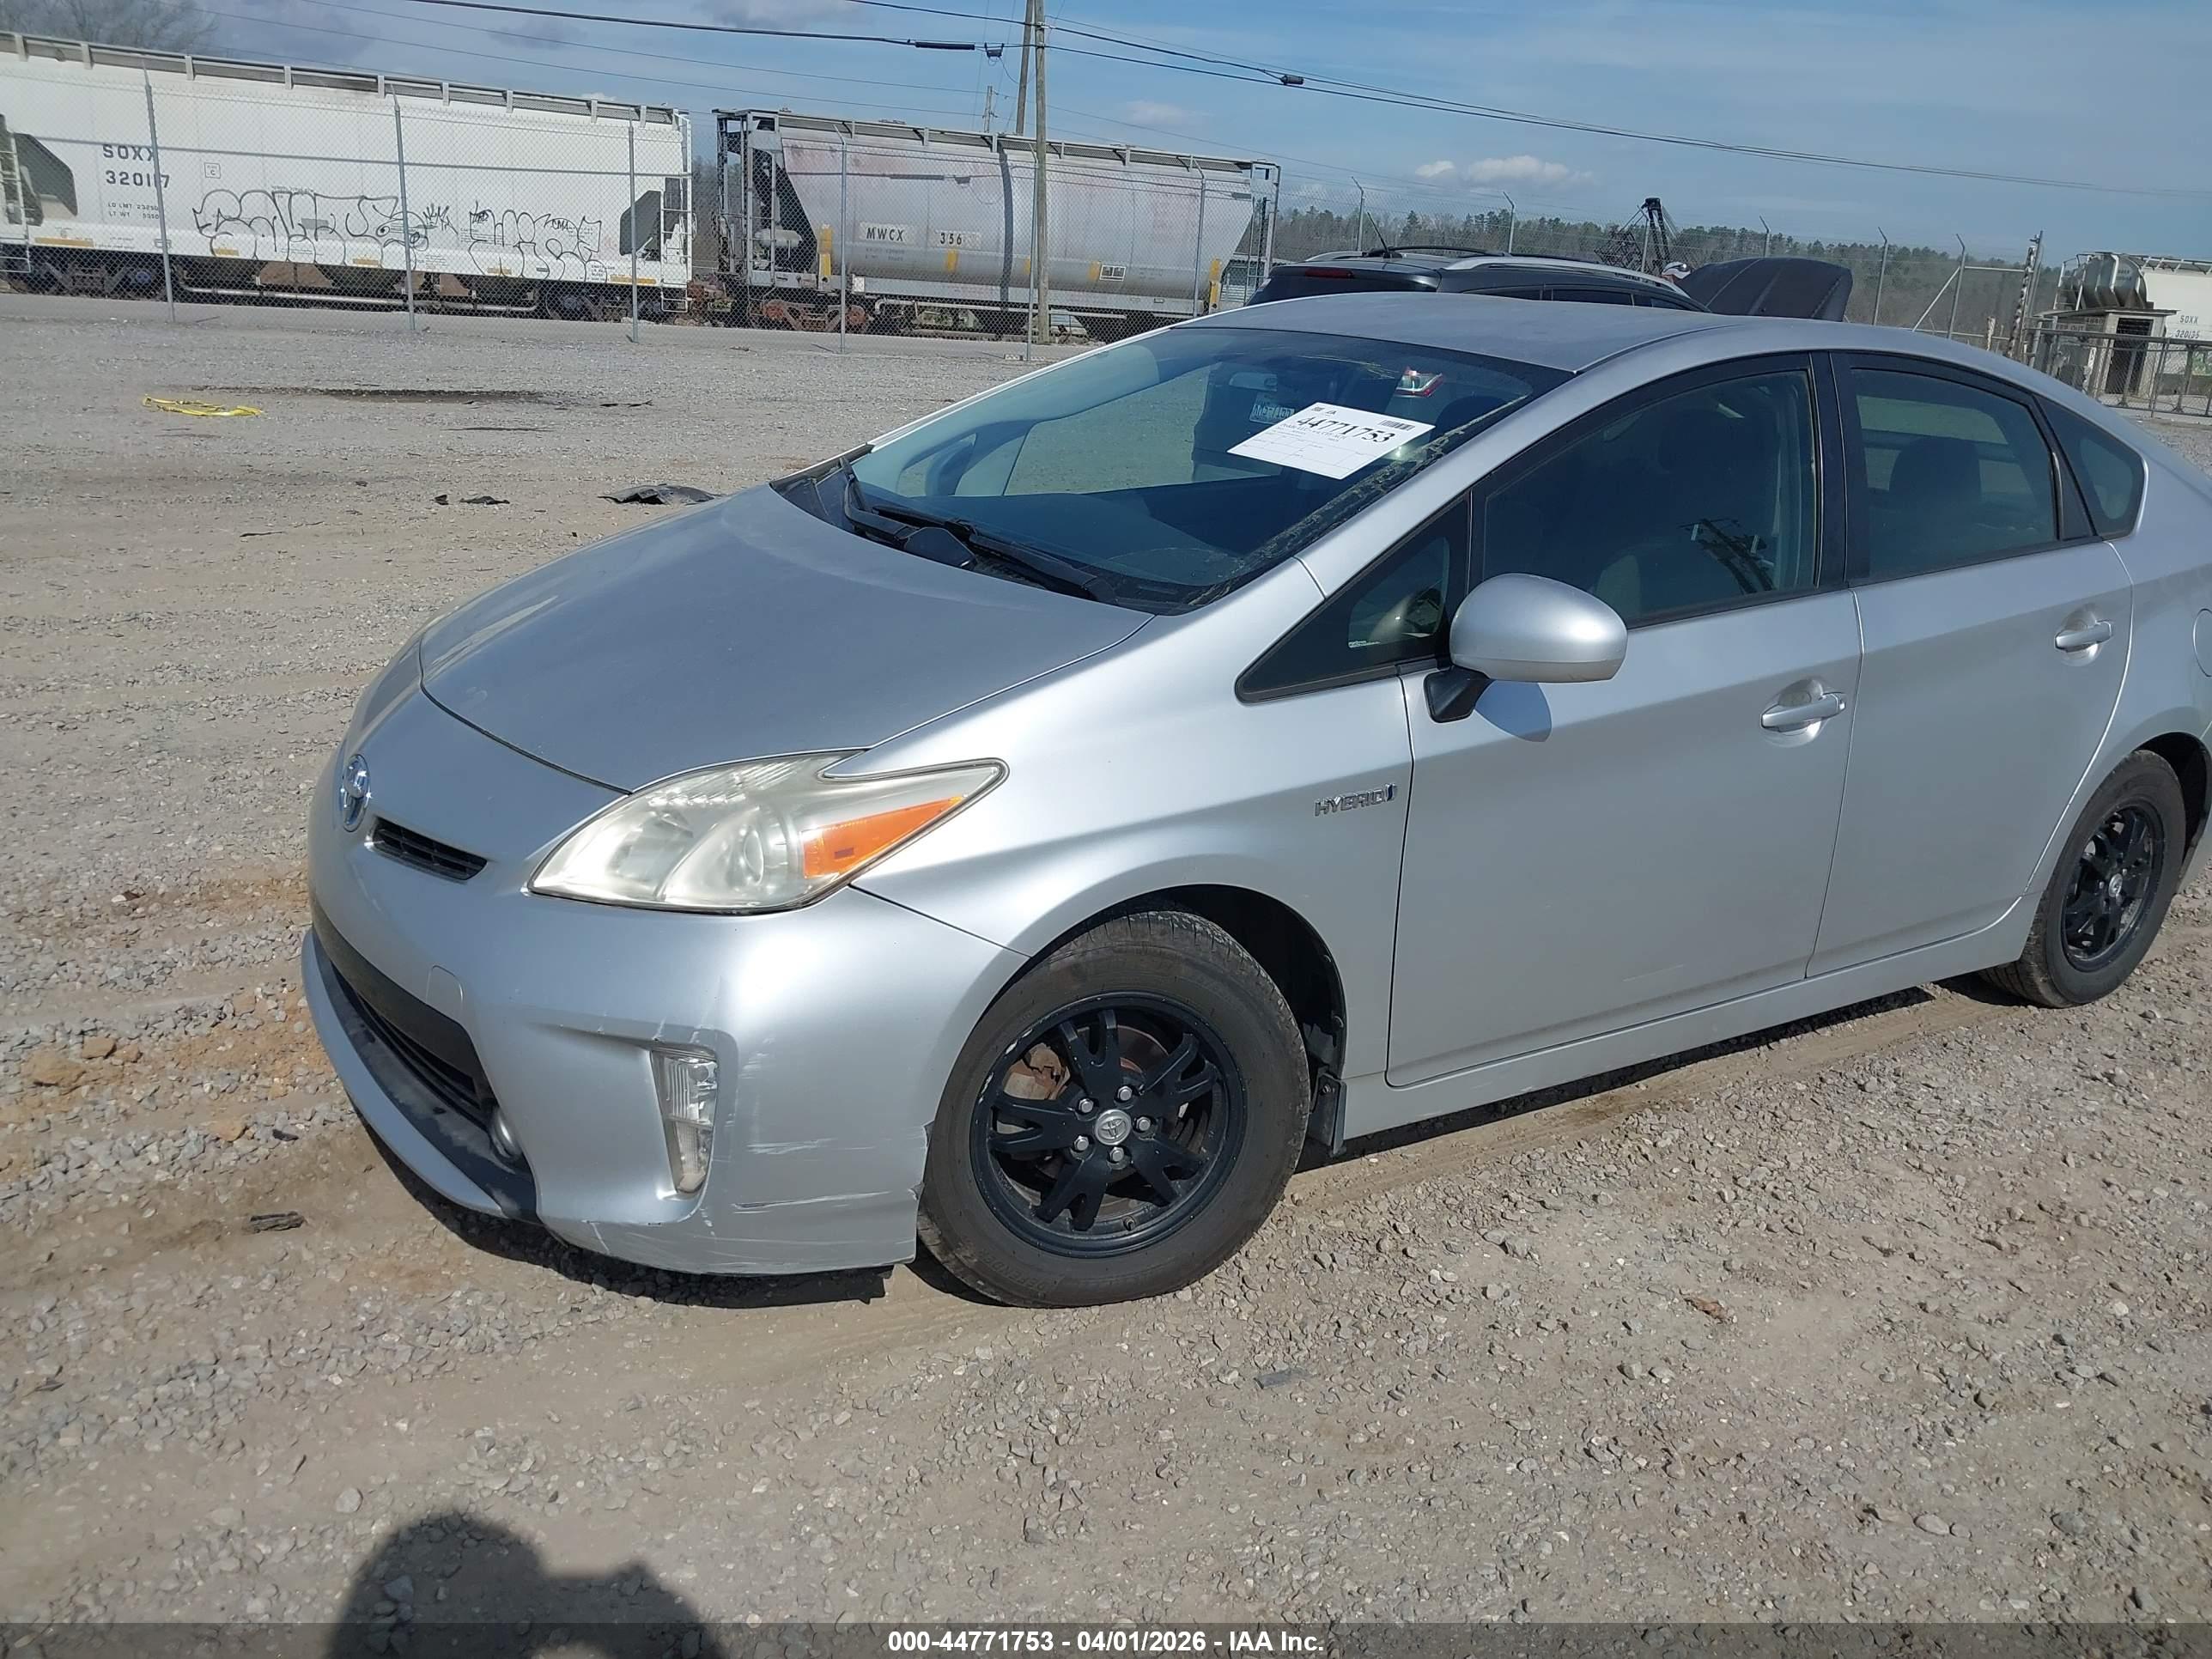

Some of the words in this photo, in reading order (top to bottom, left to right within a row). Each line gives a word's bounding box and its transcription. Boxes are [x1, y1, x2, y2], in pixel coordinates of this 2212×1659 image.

[103, 144, 155, 161] SOXX
[106, 170, 170, 188] 32017
[866, 227, 904, 241] MWCX
[940, 233, 963, 246] 356
[2179, 315, 2199, 324] SOXX
[1297, 417, 1395, 443] 44771753
[1315, 789, 1384, 817] HYBRID
